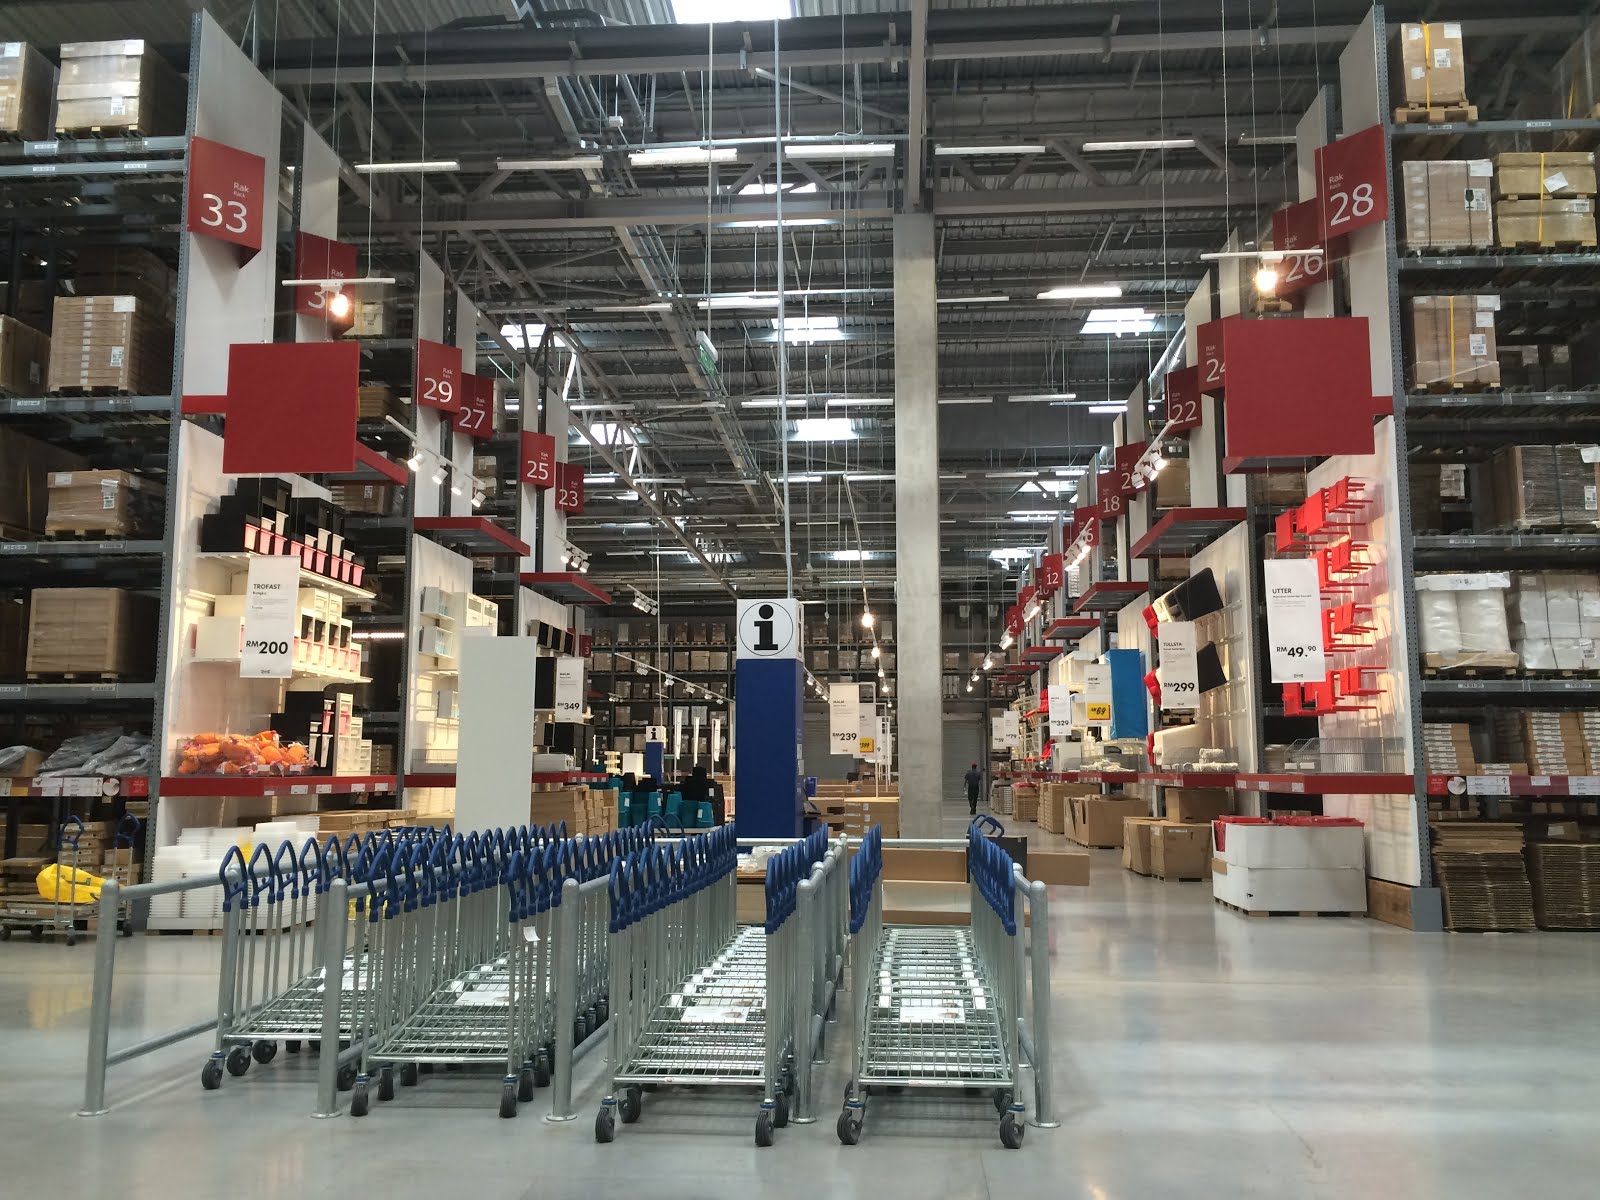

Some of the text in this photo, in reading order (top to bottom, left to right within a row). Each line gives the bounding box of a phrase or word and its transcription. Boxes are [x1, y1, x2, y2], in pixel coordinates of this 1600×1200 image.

[233, 182, 249, 193] Rak
[1329, 173, 1344, 184] Rak
[200, 193, 247, 234] 33
[1330, 183, 1374, 227] 28
[331, 268, 344, 278] Rak
[1285, 245, 1323, 283] 26
[423, 377, 453, 403] 29
[459, 406, 486, 430] 27
[1172, 400, 1197, 425] 22
[526, 460, 549, 480] 25
[558, 488, 578, 507] 23
[1102, 495, 1120, 513] 18
[1046, 572, 1059, 585] 12
[584, 646, 590, 655] 3
